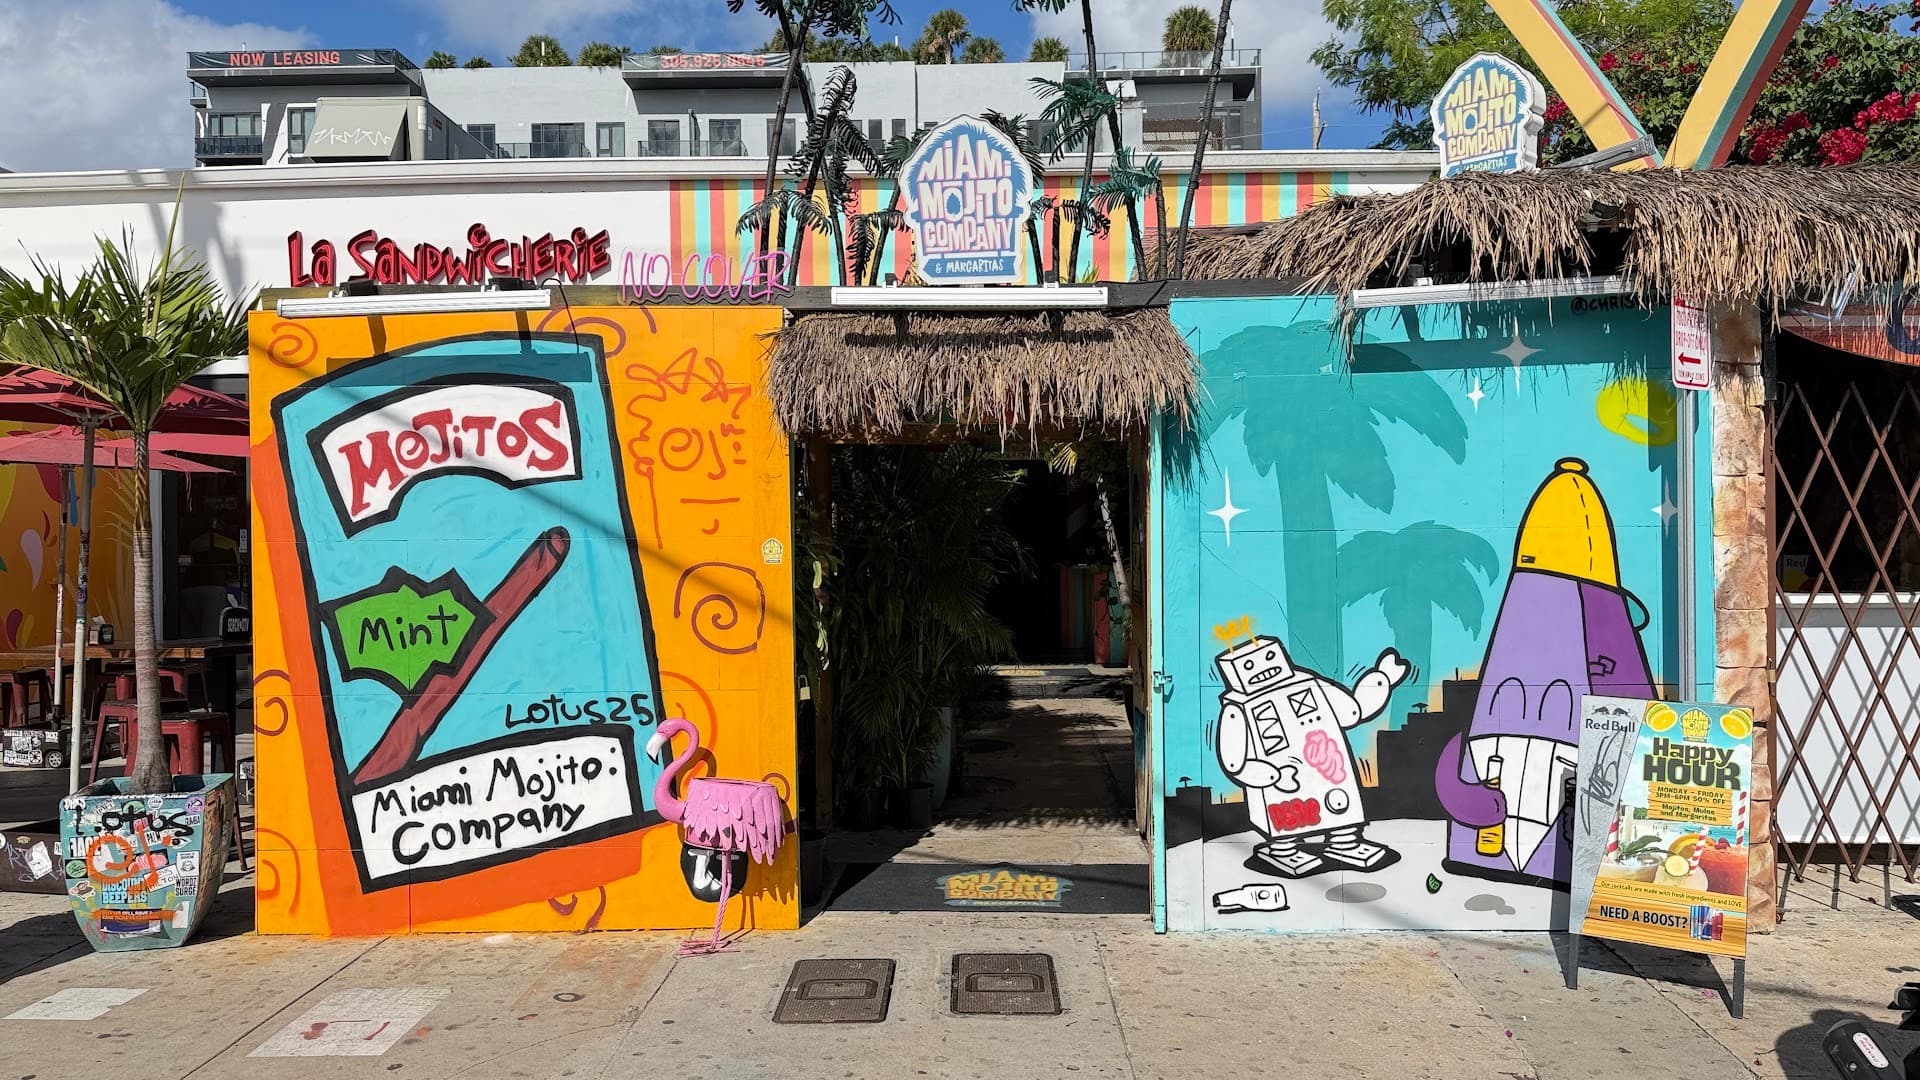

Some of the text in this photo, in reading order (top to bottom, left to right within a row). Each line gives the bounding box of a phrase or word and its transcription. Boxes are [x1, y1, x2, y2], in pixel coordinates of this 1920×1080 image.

[229, 51, 341, 67] NOW LEASING
[287, 230, 337, 287] La
[935, 259, 1004, 273] & MARGARITAS
[622, 250, 792, 303] NO COVER
[358, 605, 459, 654] Mint
[1585, 718, 1635, 733] Red Bull
[1652, 736, 1735, 769] Happy
[1643, 754, 1741, 791] HOUR
[371, 766, 473, 834] Miami
[1656, 792, 1690, 801] 3PM-6PM
[1693, 796, 1709, 804] 50%
[1657, 786, 1688, 795] MONDAY
[1698, 790, 1724, 800] FRIDAY
[1676, 811, 1717, 822] Margaritas
[392, 803, 585, 865] Company
[946, 870, 1057, 883] MIAMI
[102, 891, 148, 904] BEEPERS
[1600, 880, 1610, 888] Our
[1611, 882, 1633, 891] cocktails
[1643, 887, 1658, 895] made
[1658, 889, 1671, 897] with
[1671, 890, 1685, 899] fresh
[1685, 893, 1716, 905] ingredients
[1717, 898, 1728, 906] and
[1728, 900, 1742, 908] LOVE
[1600, 905, 1688, 929] NEED A BOOST?
